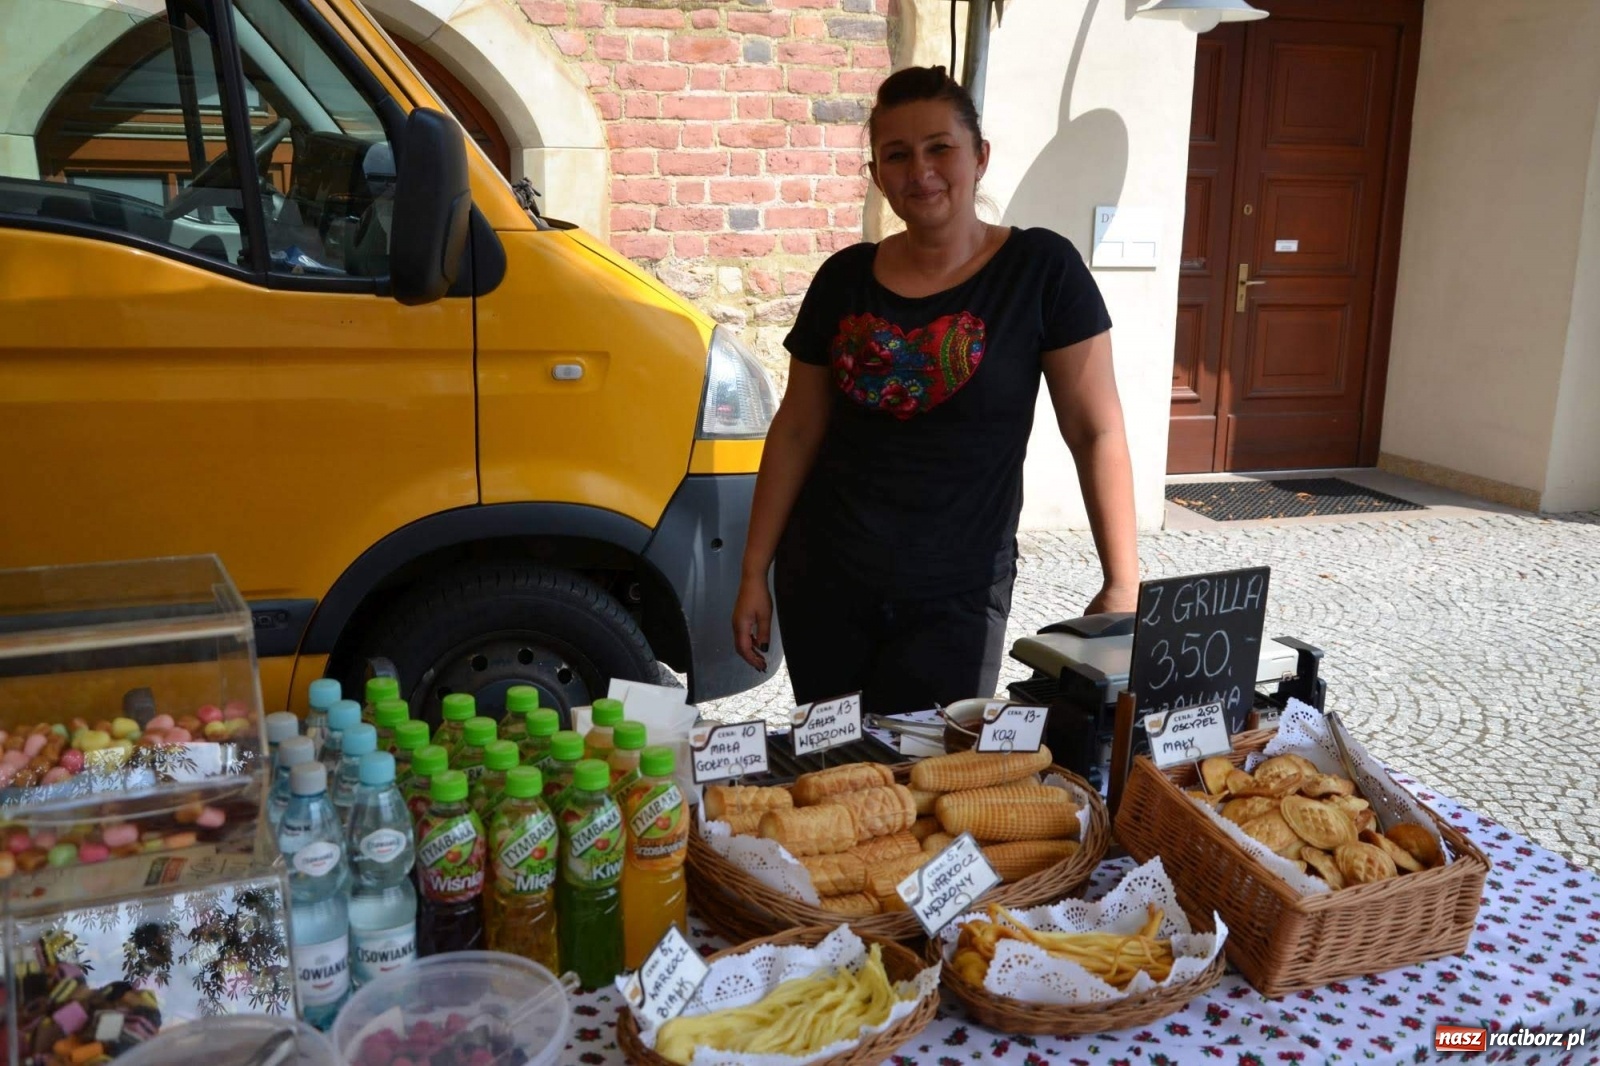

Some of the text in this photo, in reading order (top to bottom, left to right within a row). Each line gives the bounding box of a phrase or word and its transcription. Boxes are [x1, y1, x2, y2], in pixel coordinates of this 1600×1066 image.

[1171, 574, 1264, 624] GRILLA
[1173, 713, 1194, 722] CENA:
[742, 725, 756, 738] 10
[710, 741, 741, 756] MAŁA
[1163, 737, 1195, 754] MAŁY
[632, 789, 680, 833] TYMBARK
[421, 825, 475, 863] TYMBARK
[503, 816, 554, 864] TYMBARK
